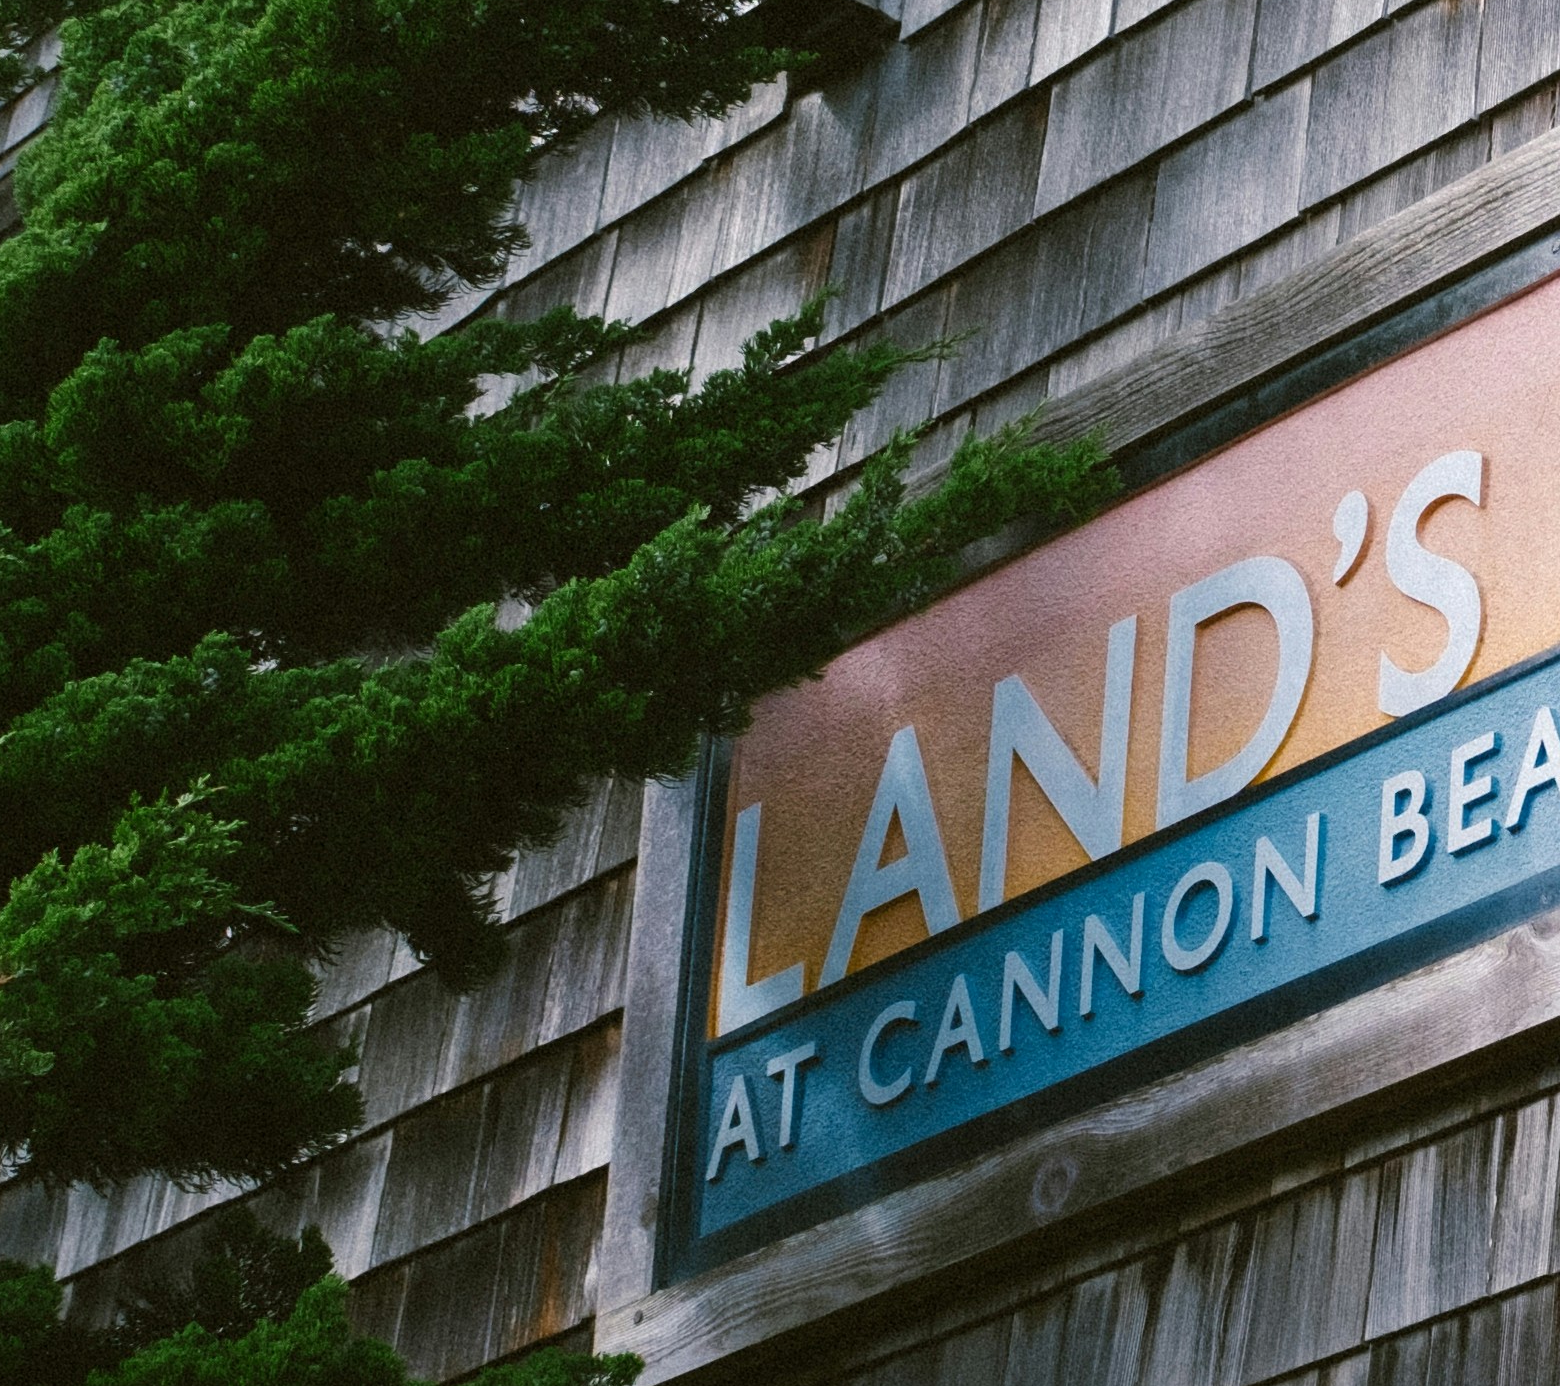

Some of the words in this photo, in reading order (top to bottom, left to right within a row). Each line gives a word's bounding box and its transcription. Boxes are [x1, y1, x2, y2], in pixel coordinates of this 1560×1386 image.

[717, 449, 1486, 1038] LAND'S
[705, 1044, 819, 1180] AT
[859, 813, 1322, 1105] CANNON
